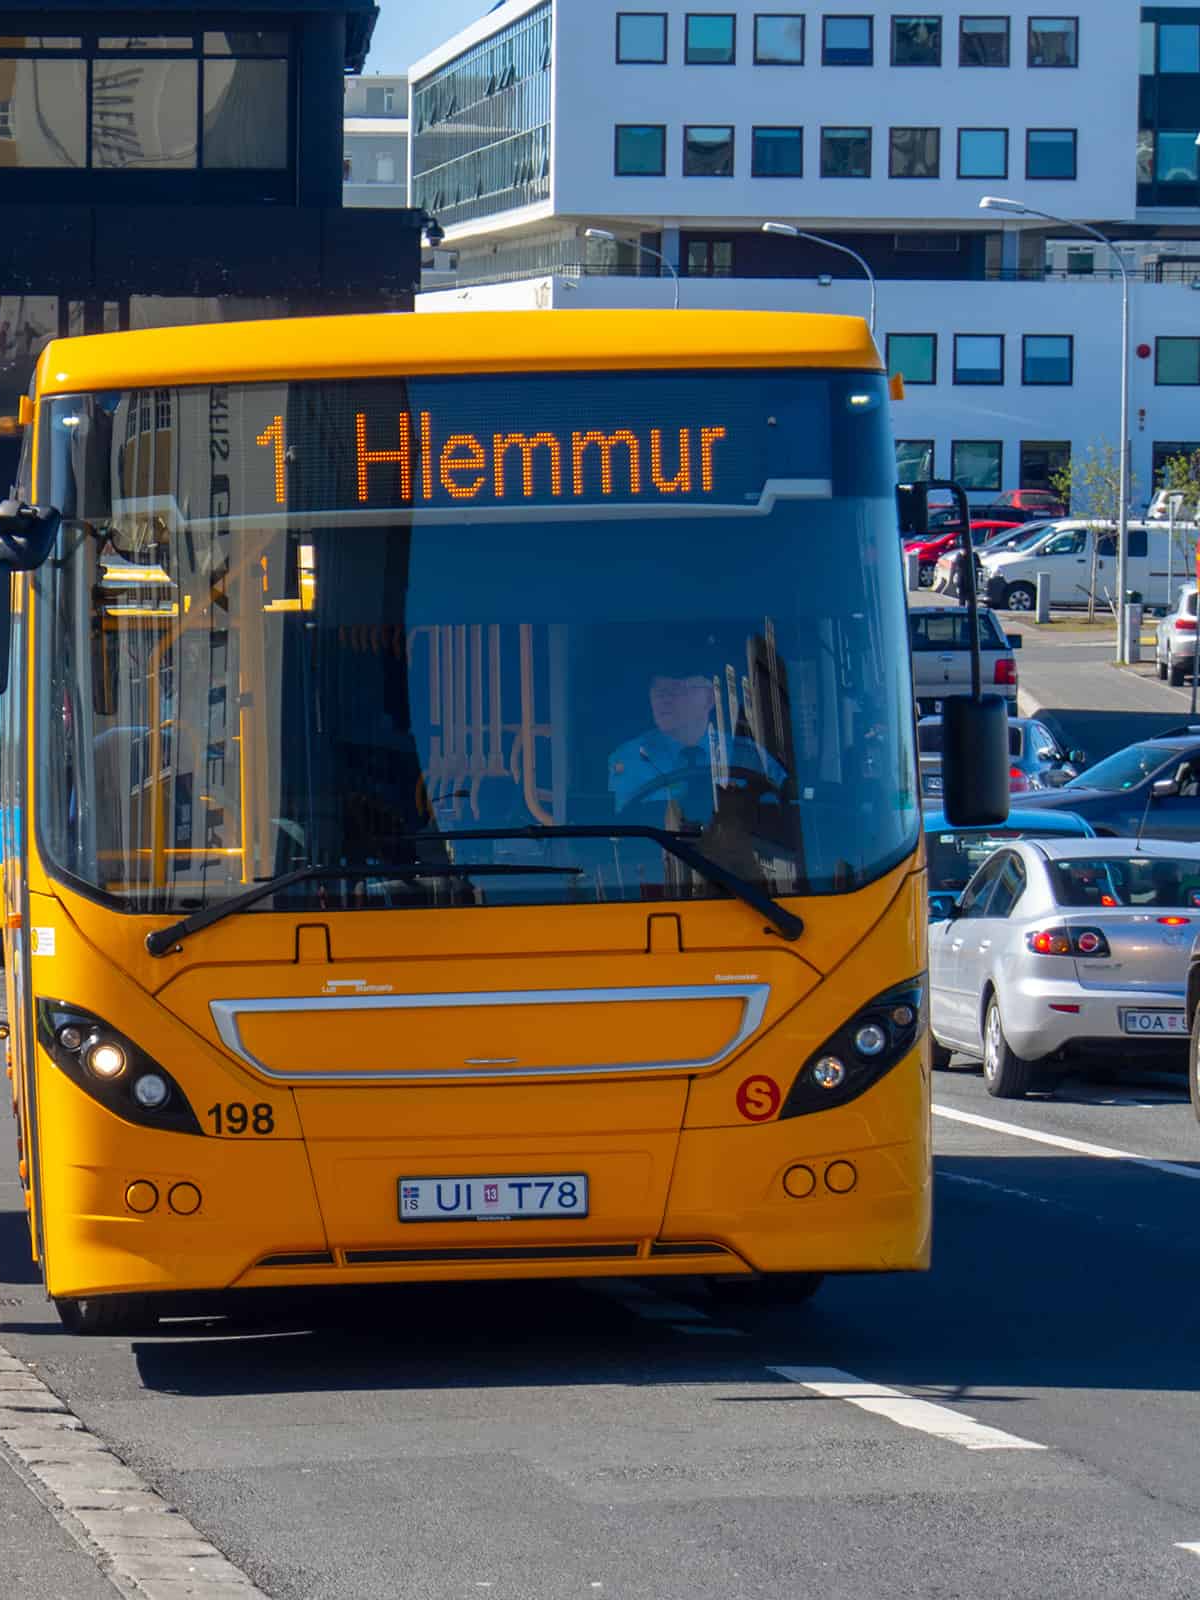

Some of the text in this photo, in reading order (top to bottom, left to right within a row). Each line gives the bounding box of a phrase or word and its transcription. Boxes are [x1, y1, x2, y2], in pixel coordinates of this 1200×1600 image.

[256, 411, 726, 503] 1 Hlemmur
[743, 1079, 774, 1116] S
[208, 1102, 275, 1135] 198
[404, 1199, 419, 1210] IS
[436, 1181, 578, 1211] UI 13 T78
